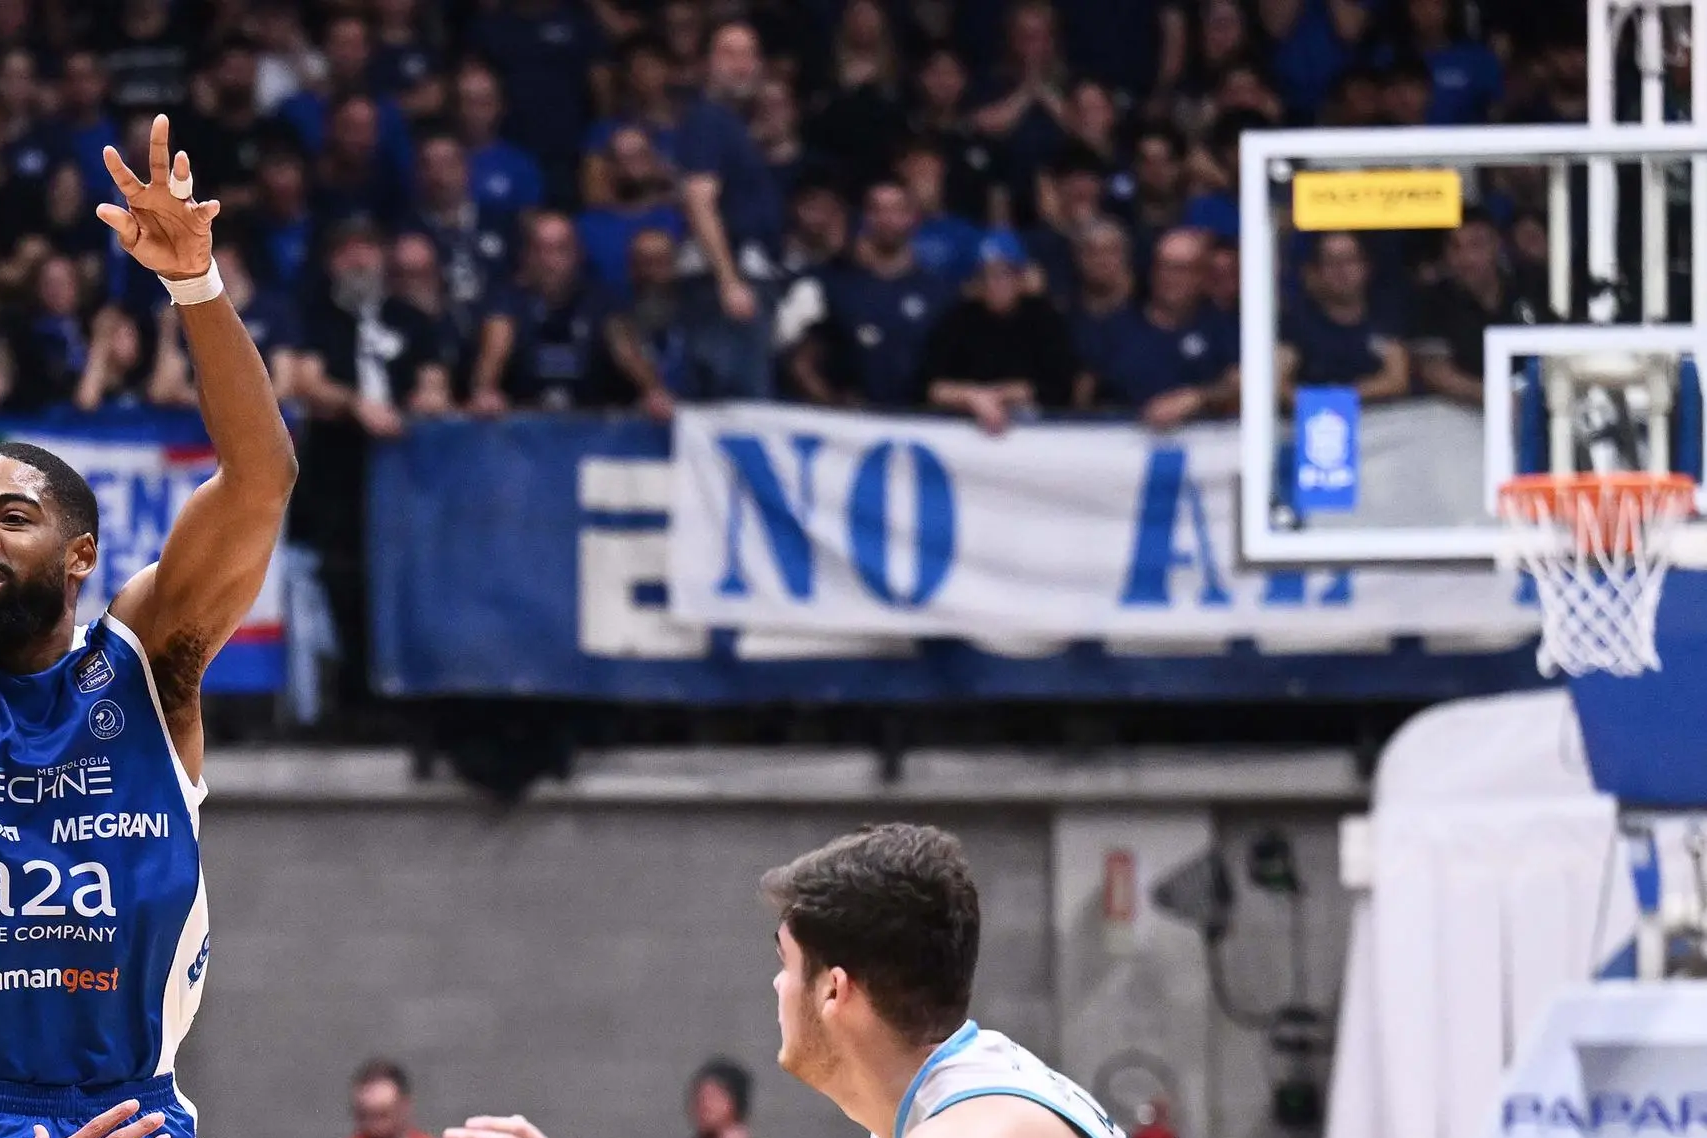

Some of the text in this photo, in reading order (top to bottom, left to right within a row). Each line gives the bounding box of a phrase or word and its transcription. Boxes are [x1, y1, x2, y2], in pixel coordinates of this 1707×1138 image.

[712, 435, 955, 608] NO
[37, 755, 111, 777] METROLOGIA
[51, 812, 169, 844] MEGRANI
[14, 924, 118, 943] COMPANY
